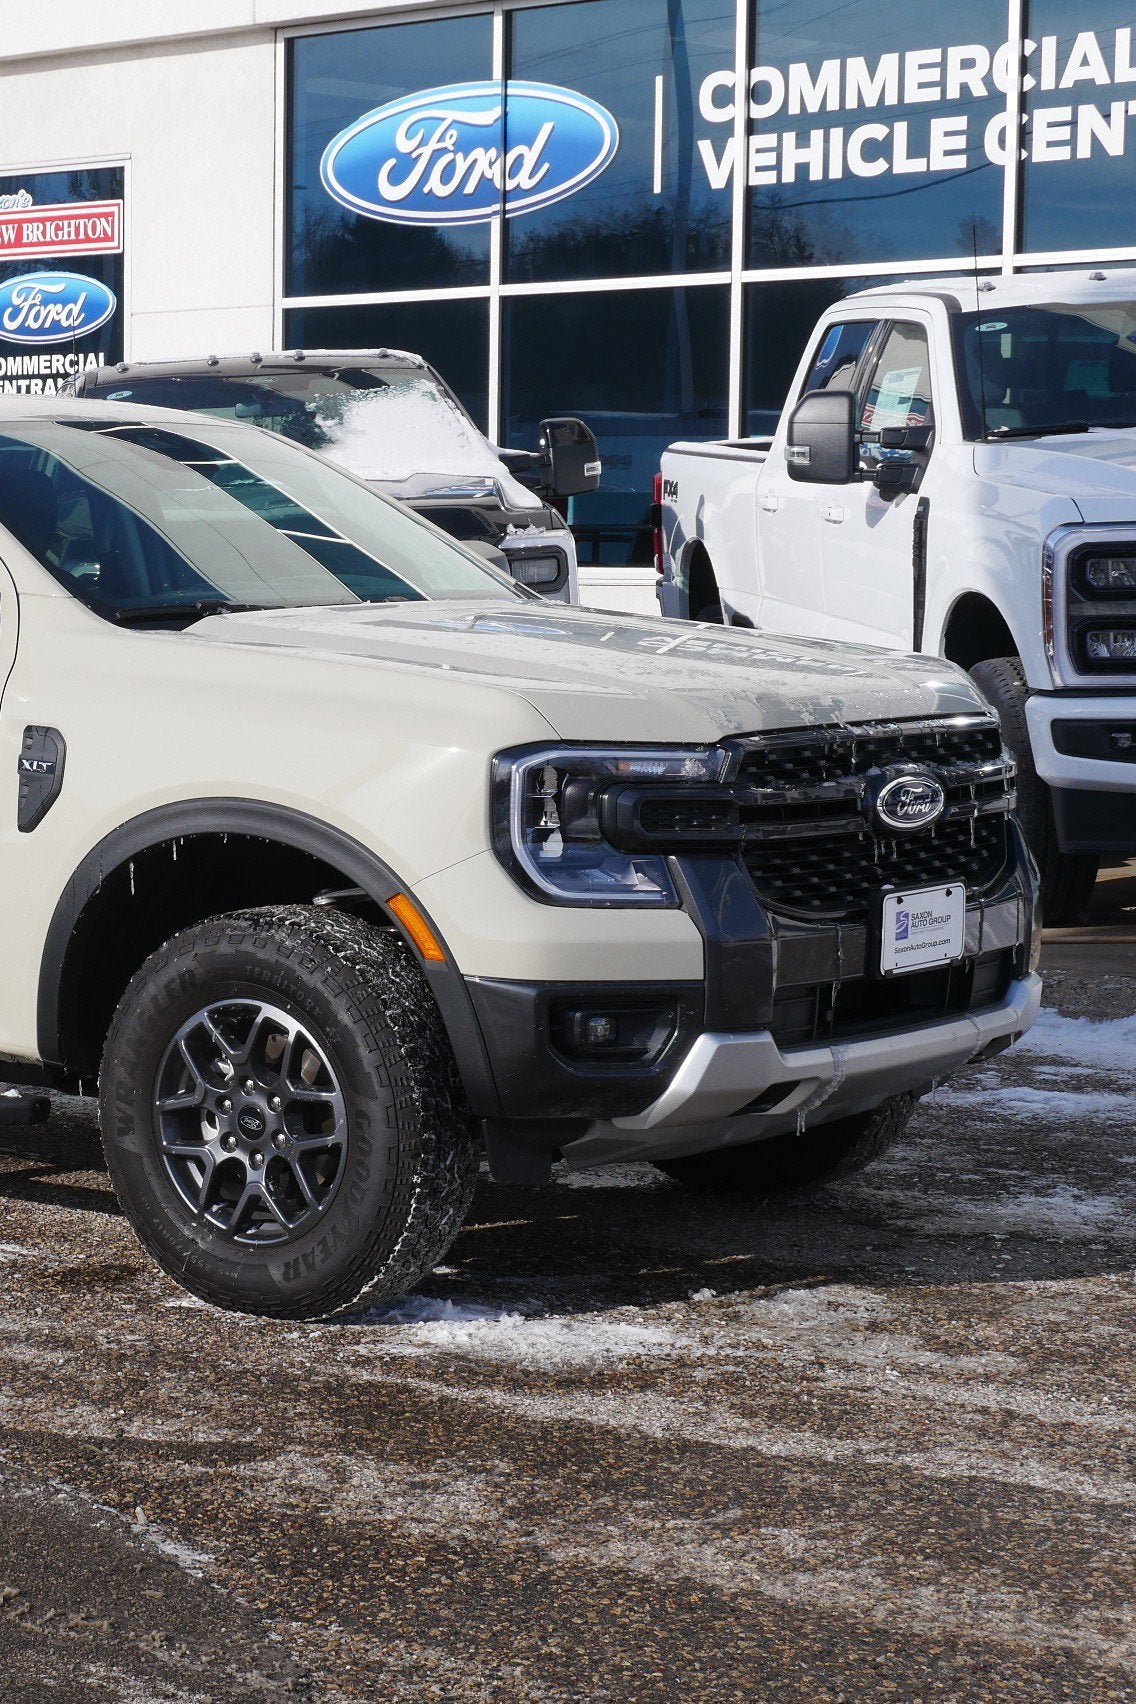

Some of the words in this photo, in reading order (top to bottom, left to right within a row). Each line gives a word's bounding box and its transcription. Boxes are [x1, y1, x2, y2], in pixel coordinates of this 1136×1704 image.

[698, 28, 1136, 123] COMMERCIAL
[377, 105, 555, 202] Ford
[697, 115, 968, 190] VEHICLE
[984, 100, 1136, 166] CEN
[21, 217, 114, 243] BRIGHTON
[2, 282, 87, 331] Ford
[21, 759, 54, 773] XLT
[911, 910, 933, 921] SAXON
[911, 919, 928, 929] AUTO
[928, 914, 951, 926] GROUP
